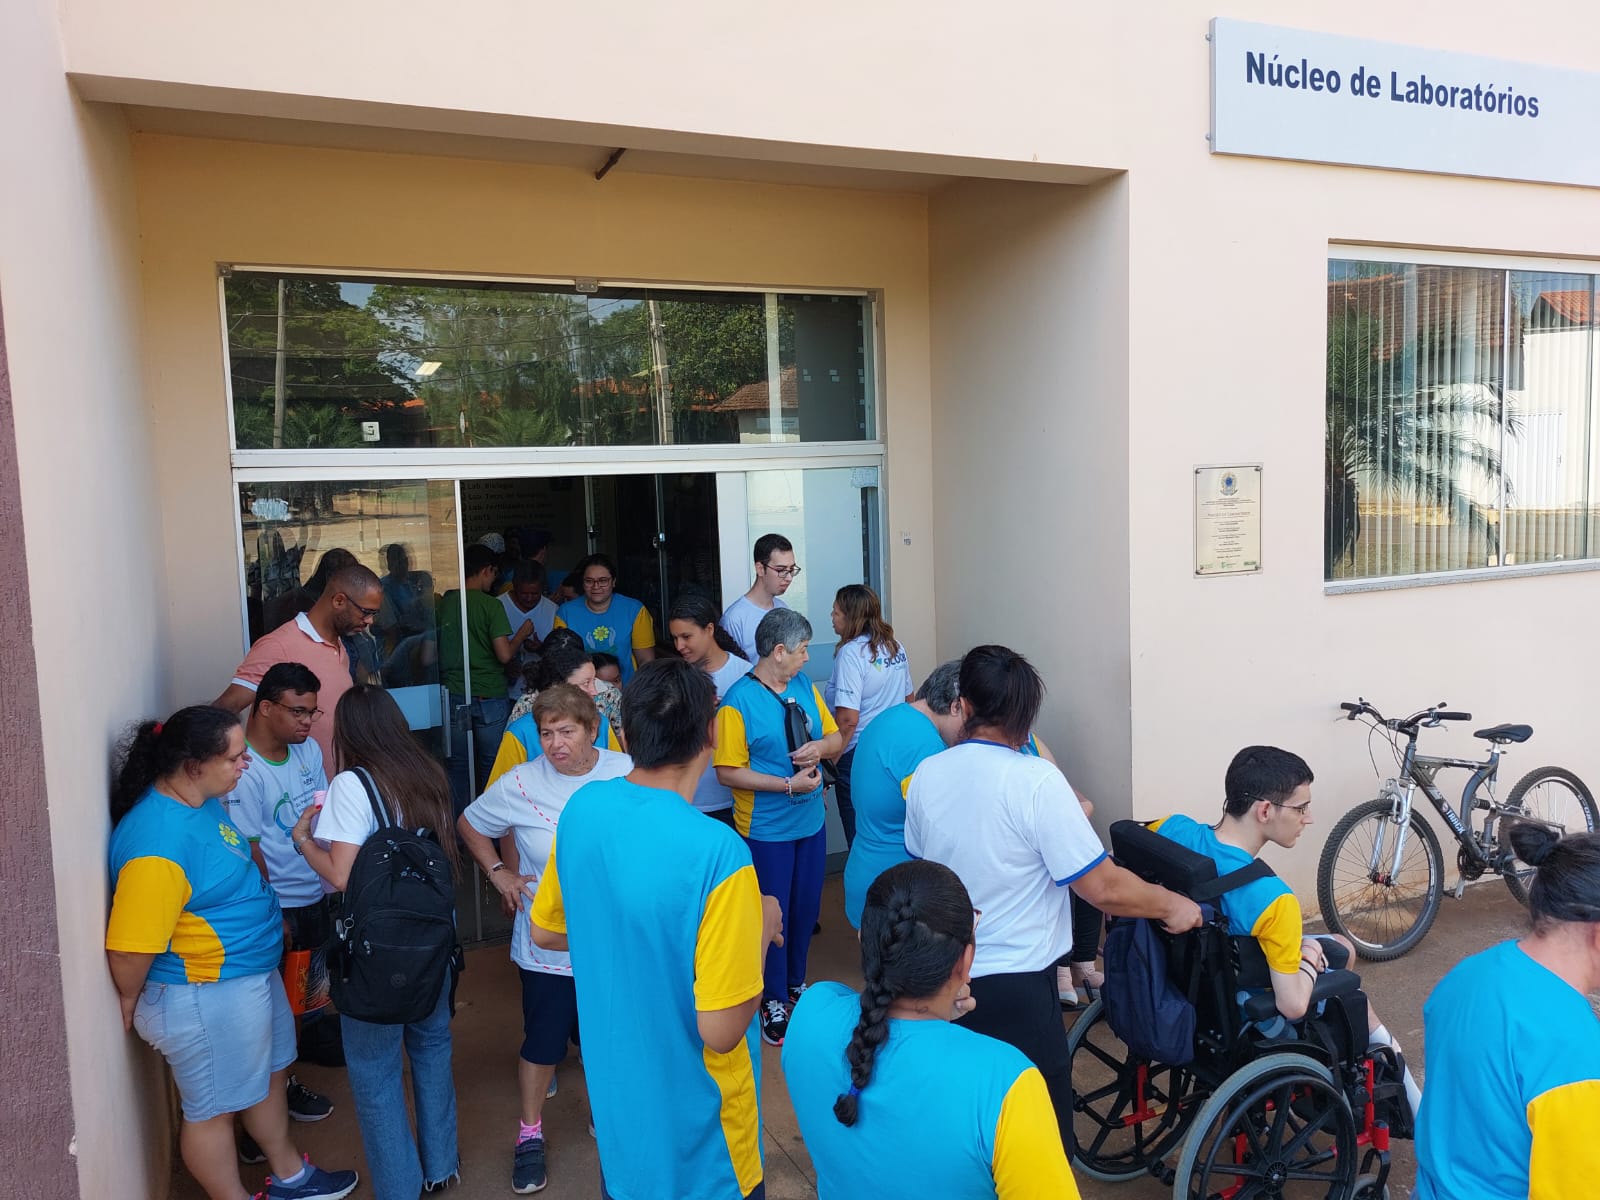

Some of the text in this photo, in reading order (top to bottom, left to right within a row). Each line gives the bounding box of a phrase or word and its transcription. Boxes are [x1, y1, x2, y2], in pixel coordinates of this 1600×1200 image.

[1246, 51, 1539, 118] Núcleo de Laboratórios
